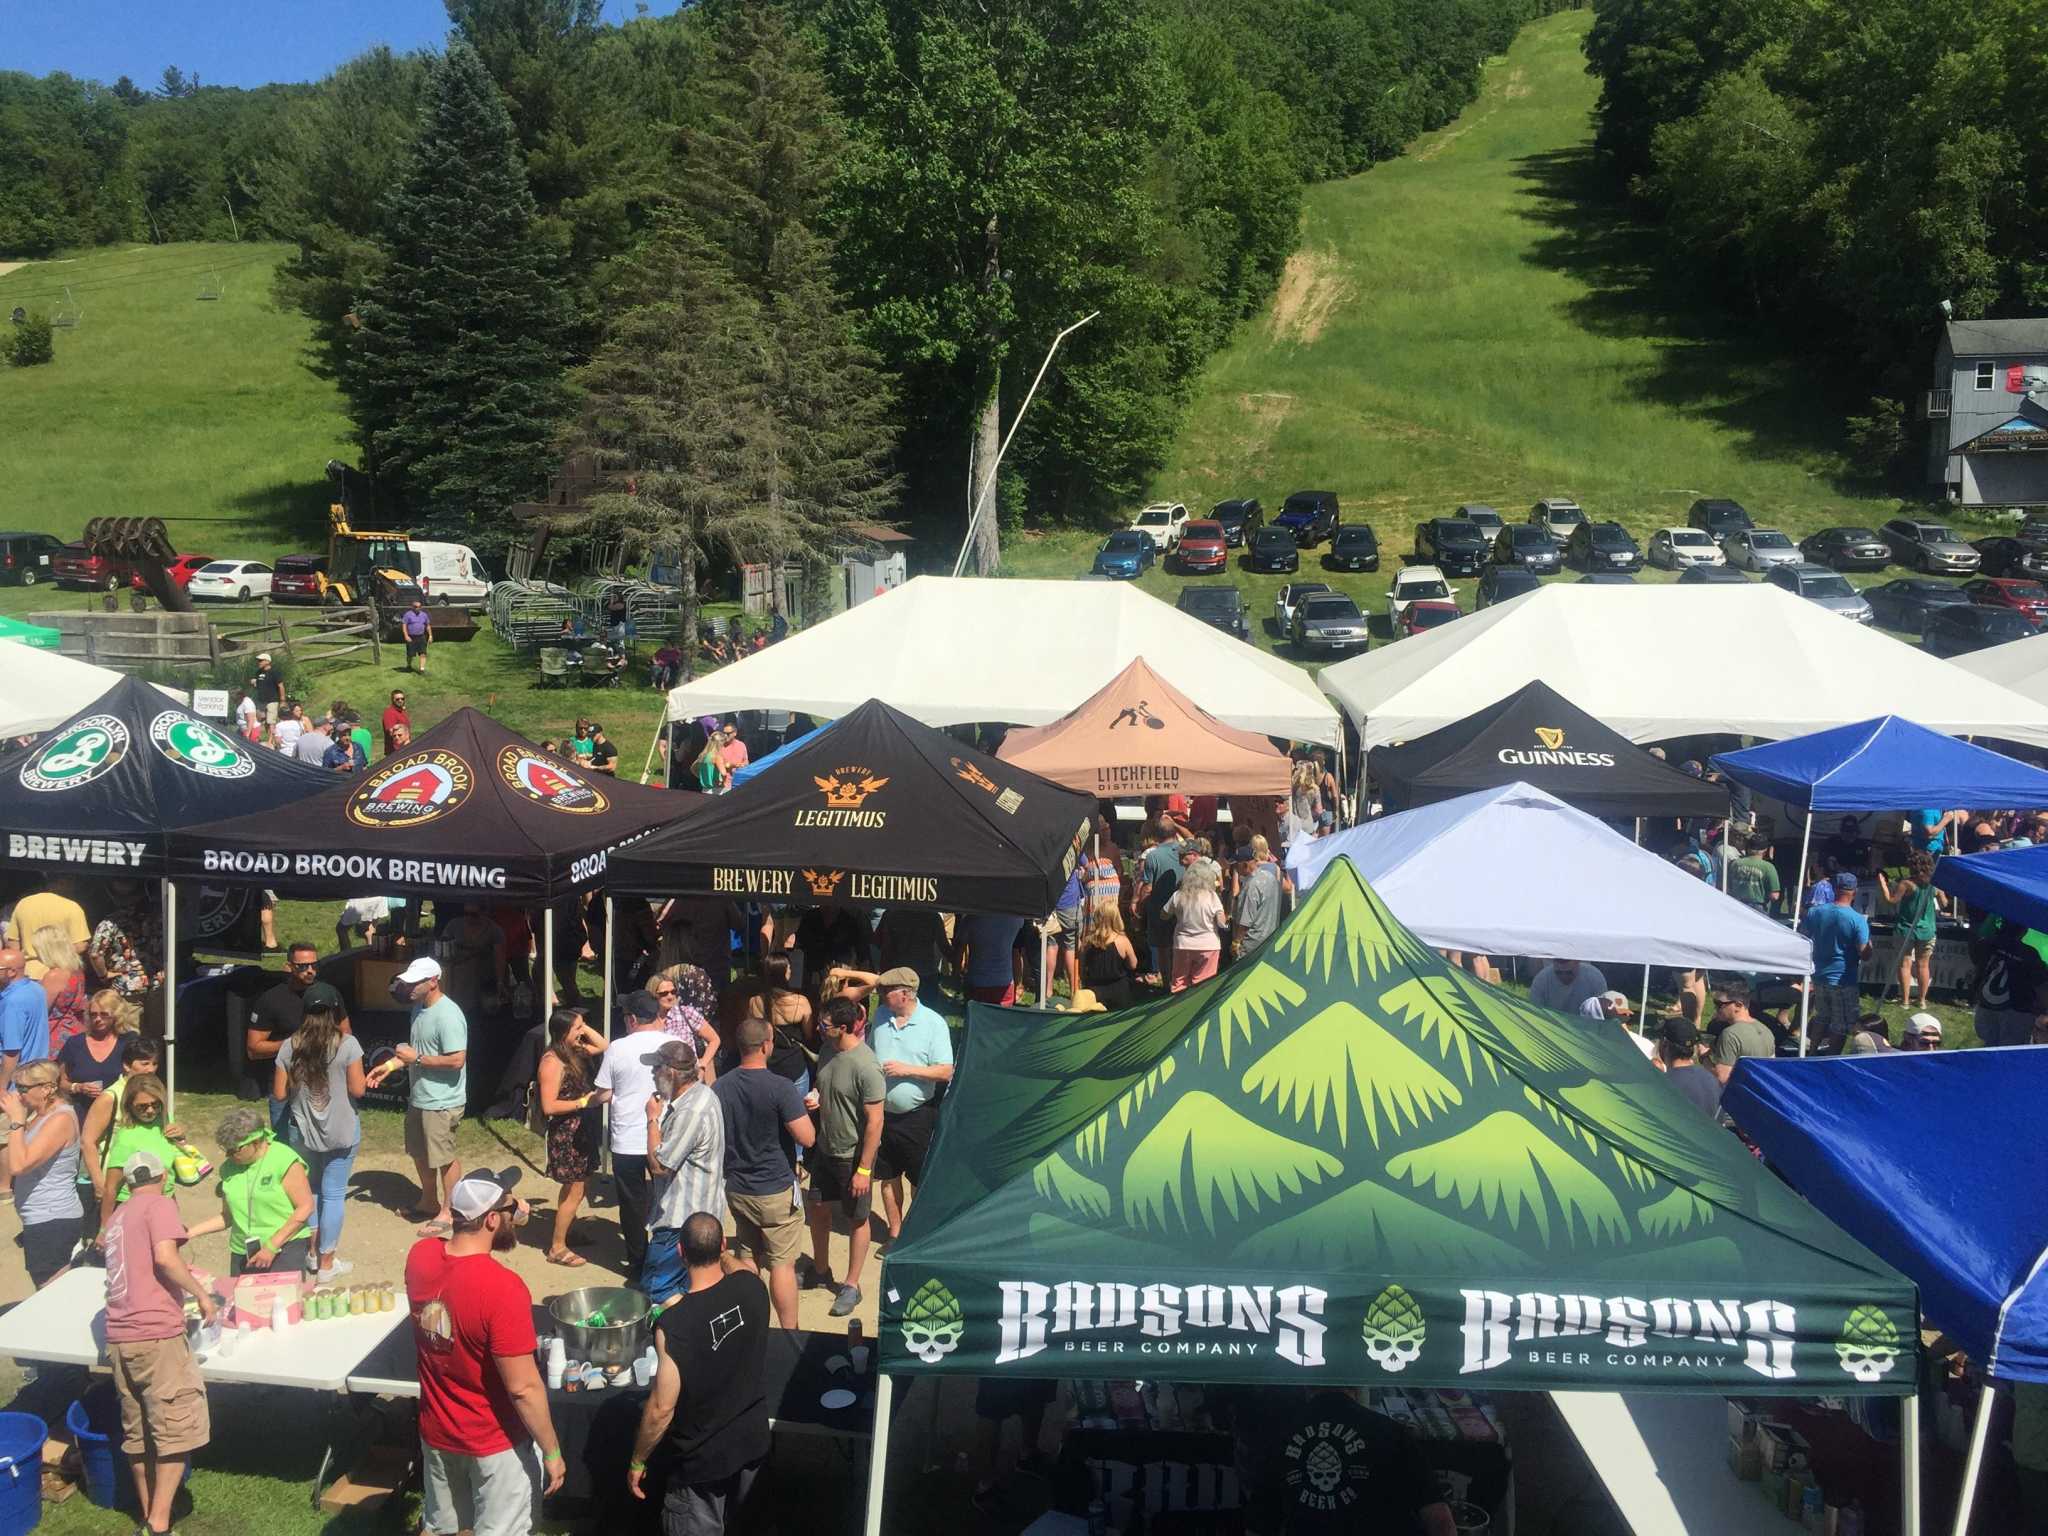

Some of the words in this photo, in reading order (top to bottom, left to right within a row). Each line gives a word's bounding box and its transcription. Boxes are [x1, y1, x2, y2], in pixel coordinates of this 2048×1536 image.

[502, 752, 525, 789] BROAD
[1498, 748, 1616, 767] GUINNESS
[369, 754, 428, 788] BROAD
[433, 753, 468, 791] BROOK
[1097, 766, 1180, 782] LITCHFIELD
[1098, 782, 1179, 791] DISTILLERY
[365, 802, 435, 813] BREWING
[795, 809, 887, 829] LEGITIMUS
[9, 834, 147, 867] BREWERY
[204, 850, 290, 874] BROAD
[295, 854, 383, 879] BROOK
[388, 858, 506, 889] BREWING
[713, 867, 795, 894] BREWERY
[851, 873, 938, 902] LEGITIMUS
[995, 1281, 1328, 1367] BADSONS
[1459, 1289, 1797, 1379] BADSONS
[1064, 1341, 1125, 1353] BEER
[1140, 1341, 1259, 1355] COMPANY
[1528, 1351, 1591, 1365] BEER
[1607, 1353, 1727, 1367] COMPANY
[1284, 1421, 1366, 1459] BADSONS
[1300, 1488, 1336, 1510] BEER
